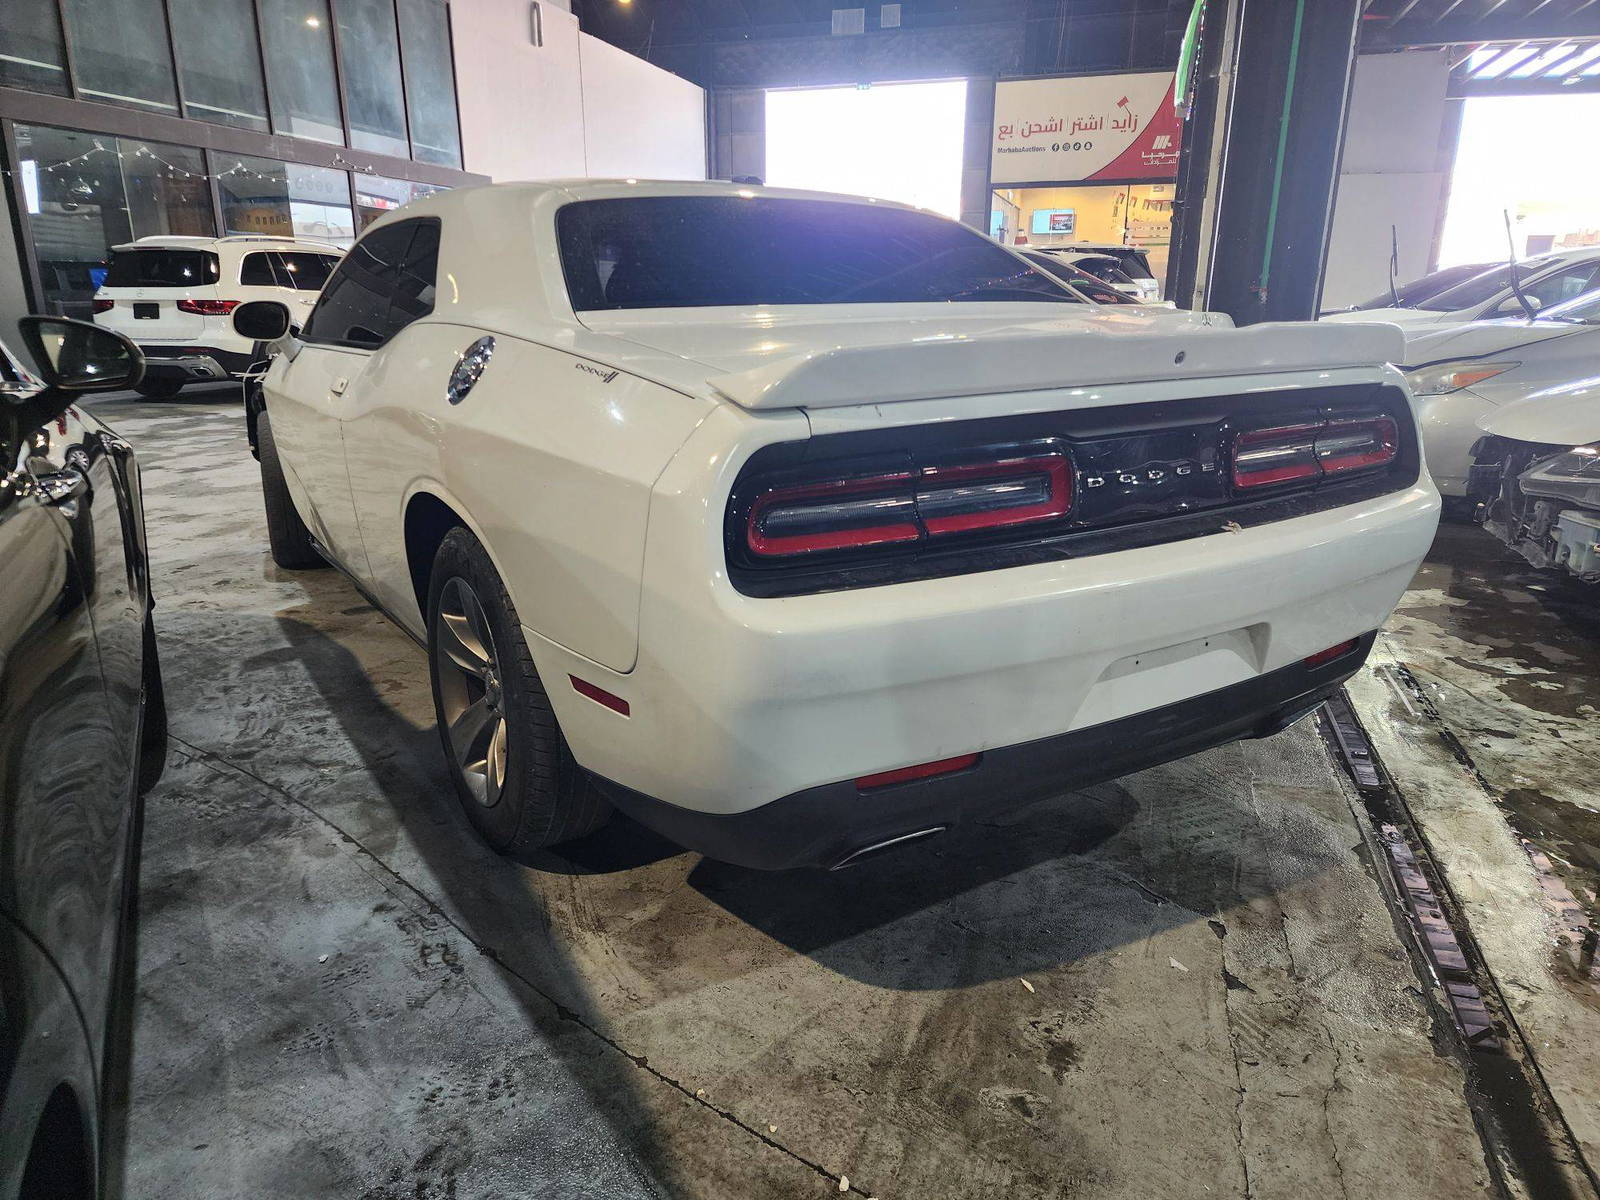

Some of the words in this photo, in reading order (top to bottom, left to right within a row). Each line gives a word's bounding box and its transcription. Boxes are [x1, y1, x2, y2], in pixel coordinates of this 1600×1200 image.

[998, 124, 1013, 140] بع
[1021, 116, 1063, 138] اشحن
[1069, 114, 1103, 136] اشتر
[1112, 112, 1138, 133] زايد
[1087, 462, 1215, 488] DODGE
